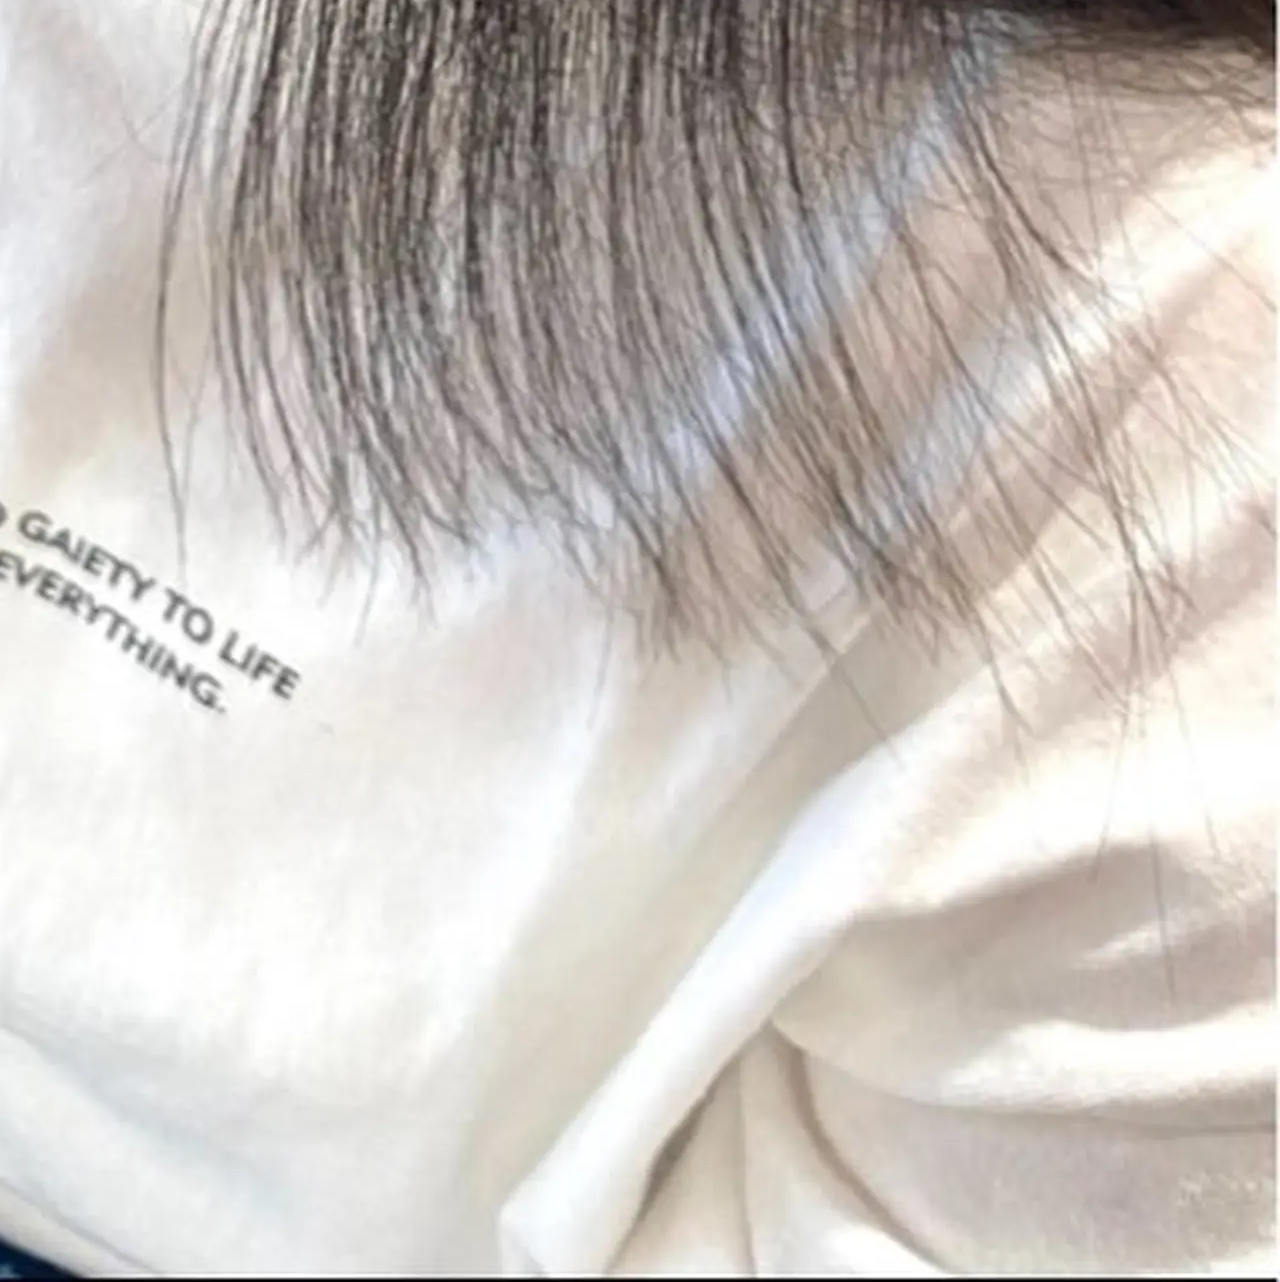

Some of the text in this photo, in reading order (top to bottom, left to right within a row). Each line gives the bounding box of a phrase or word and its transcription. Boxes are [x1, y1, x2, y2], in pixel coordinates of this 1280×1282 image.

[18, 512, 156, 603] GAIETY
[161, 587, 214, 644] TO
[218, 632, 302, 701] LIFE
